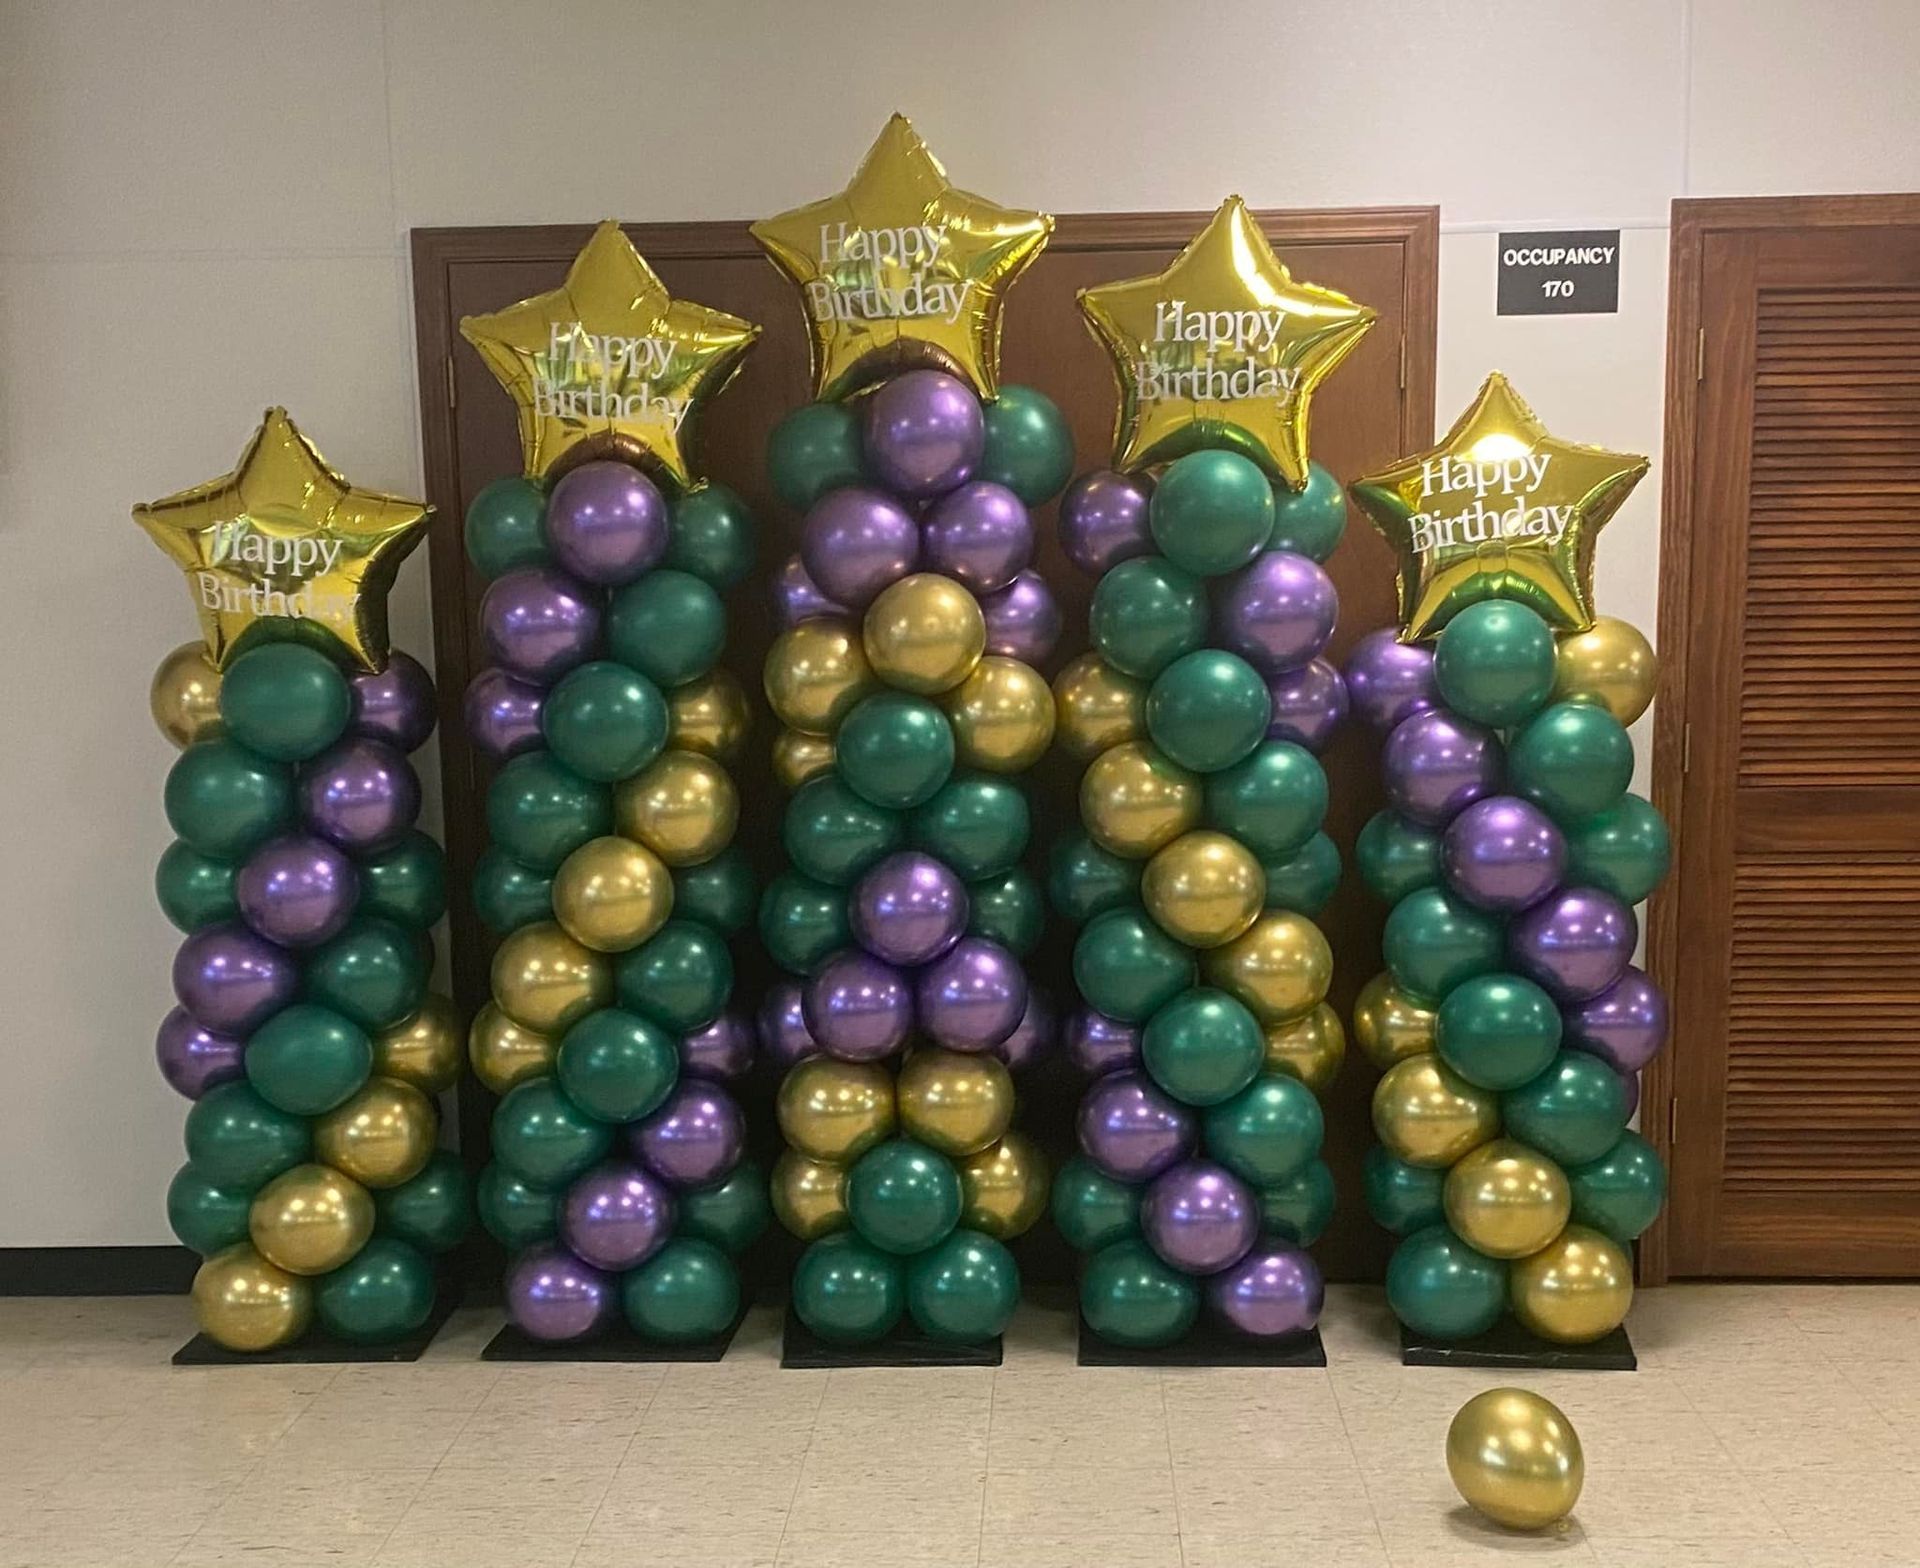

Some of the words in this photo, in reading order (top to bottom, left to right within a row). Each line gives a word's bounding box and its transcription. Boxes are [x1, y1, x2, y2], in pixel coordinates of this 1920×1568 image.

[819, 222, 948, 269] Happy
[1503, 247, 1615, 266] OCCUPANCY
[810, 272, 972, 325] Birthday
[1541, 280, 1575, 298] 170
[548, 321, 678, 380] Happy
[1154, 300, 1287, 353] Happy
[533, 374, 695, 434] Birthday
[1136, 356, 1303, 408] Birthday
[1421, 454, 1553, 498] Happy
[212, 520, 344, 577] Happy
[1407, 495, 1576, 554] Birthday
